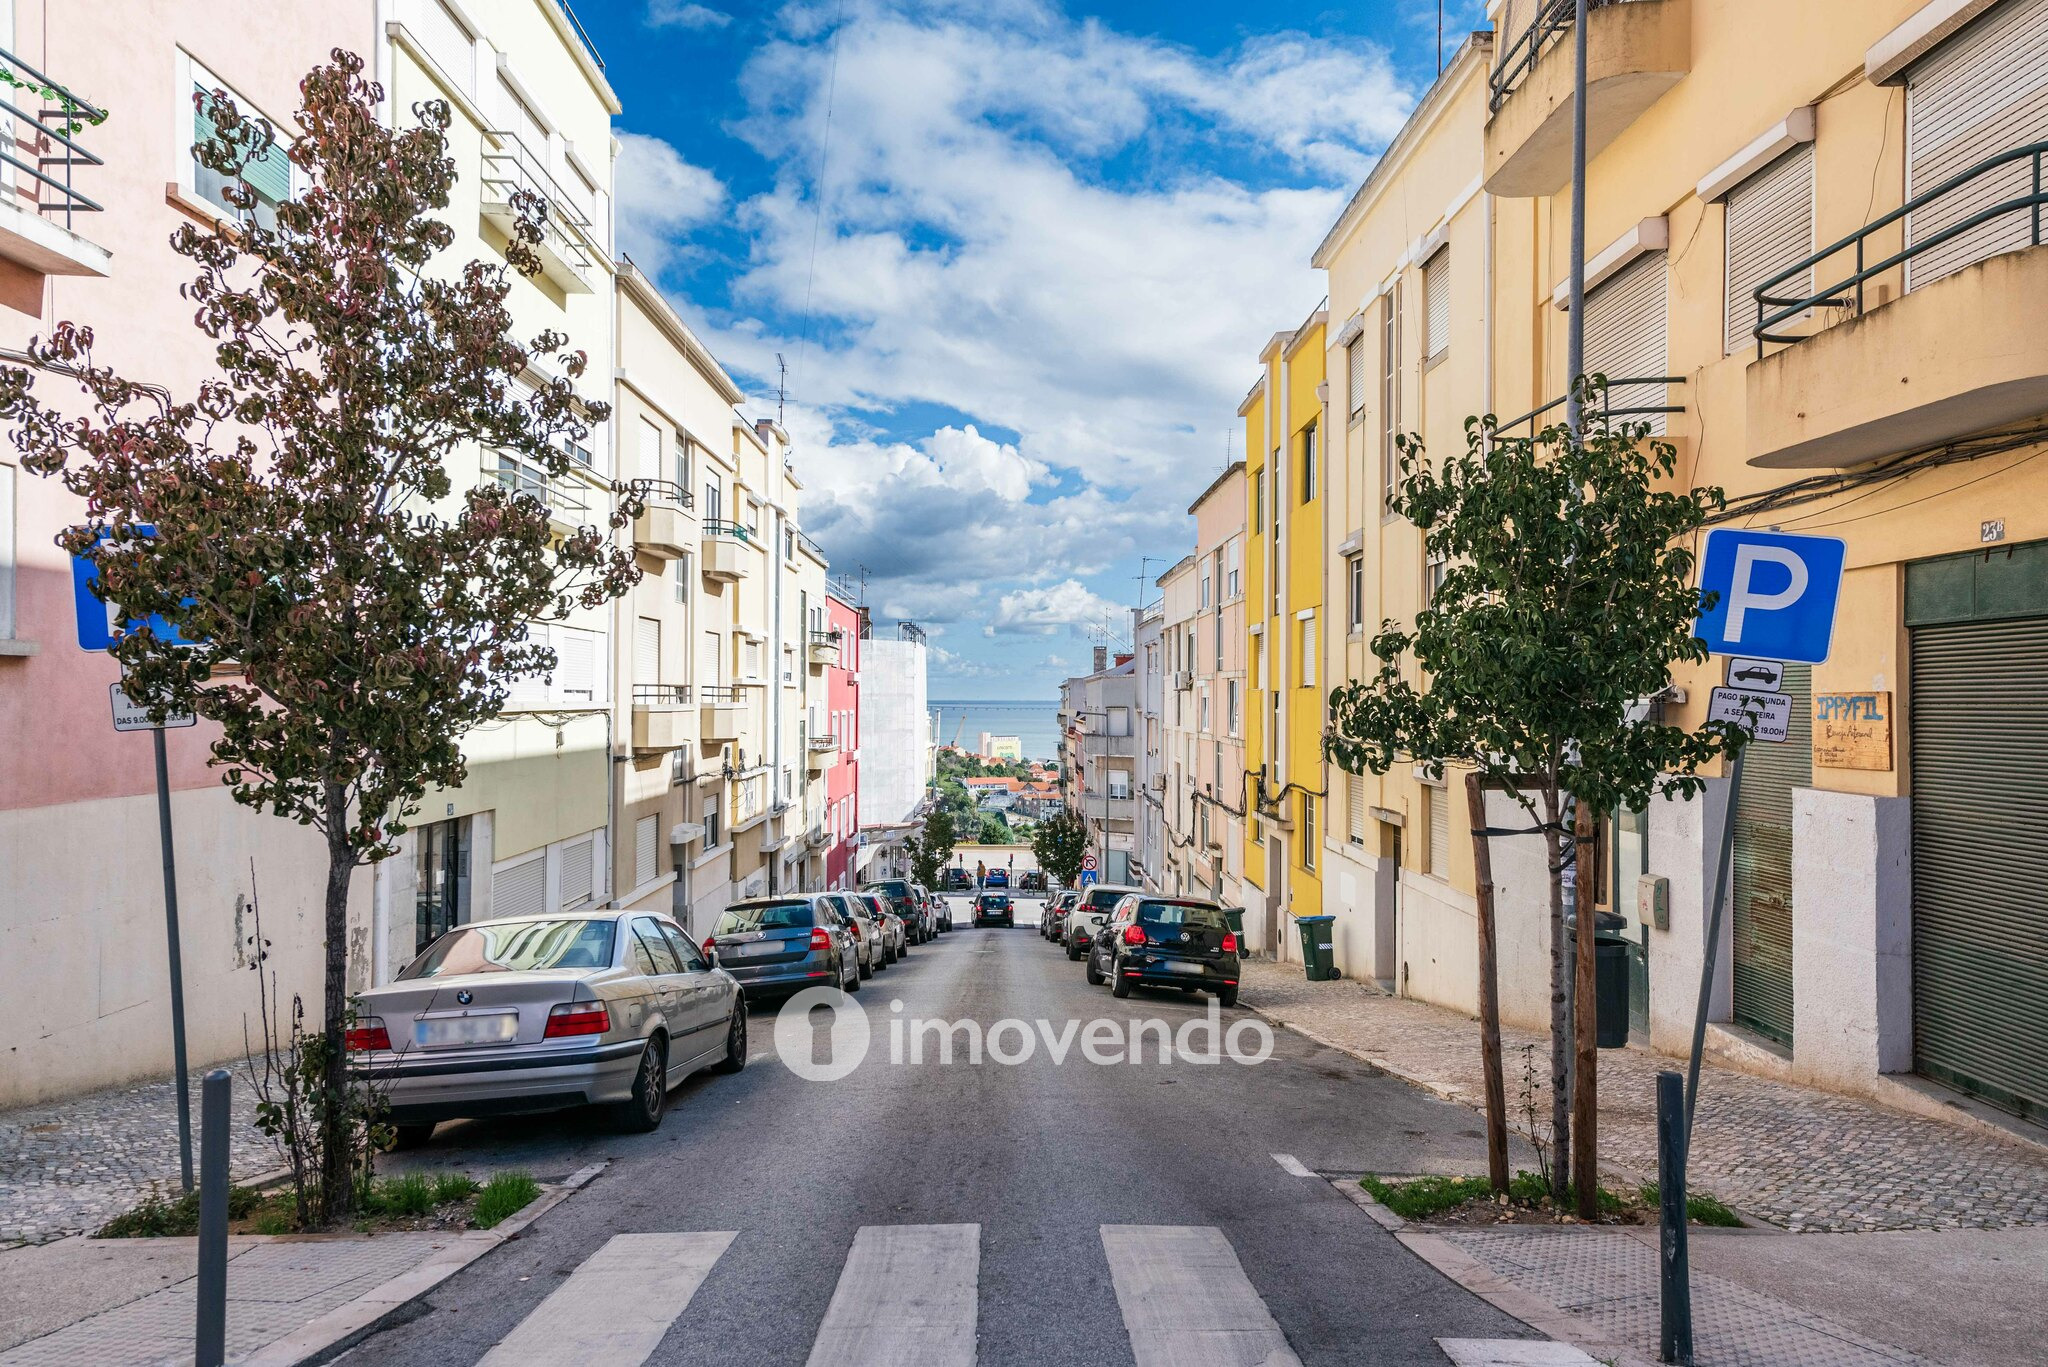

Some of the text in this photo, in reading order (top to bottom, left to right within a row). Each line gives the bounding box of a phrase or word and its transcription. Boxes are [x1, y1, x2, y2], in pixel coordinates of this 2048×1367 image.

[1982, 521, 2004, 541] 23B
[1723, 543, 1809, 643] P
[1717, 692, 1738, 701] PAGO
[116, 717, 132, 725] DAS
[1760, 726, 1785, 736] 19.00H
